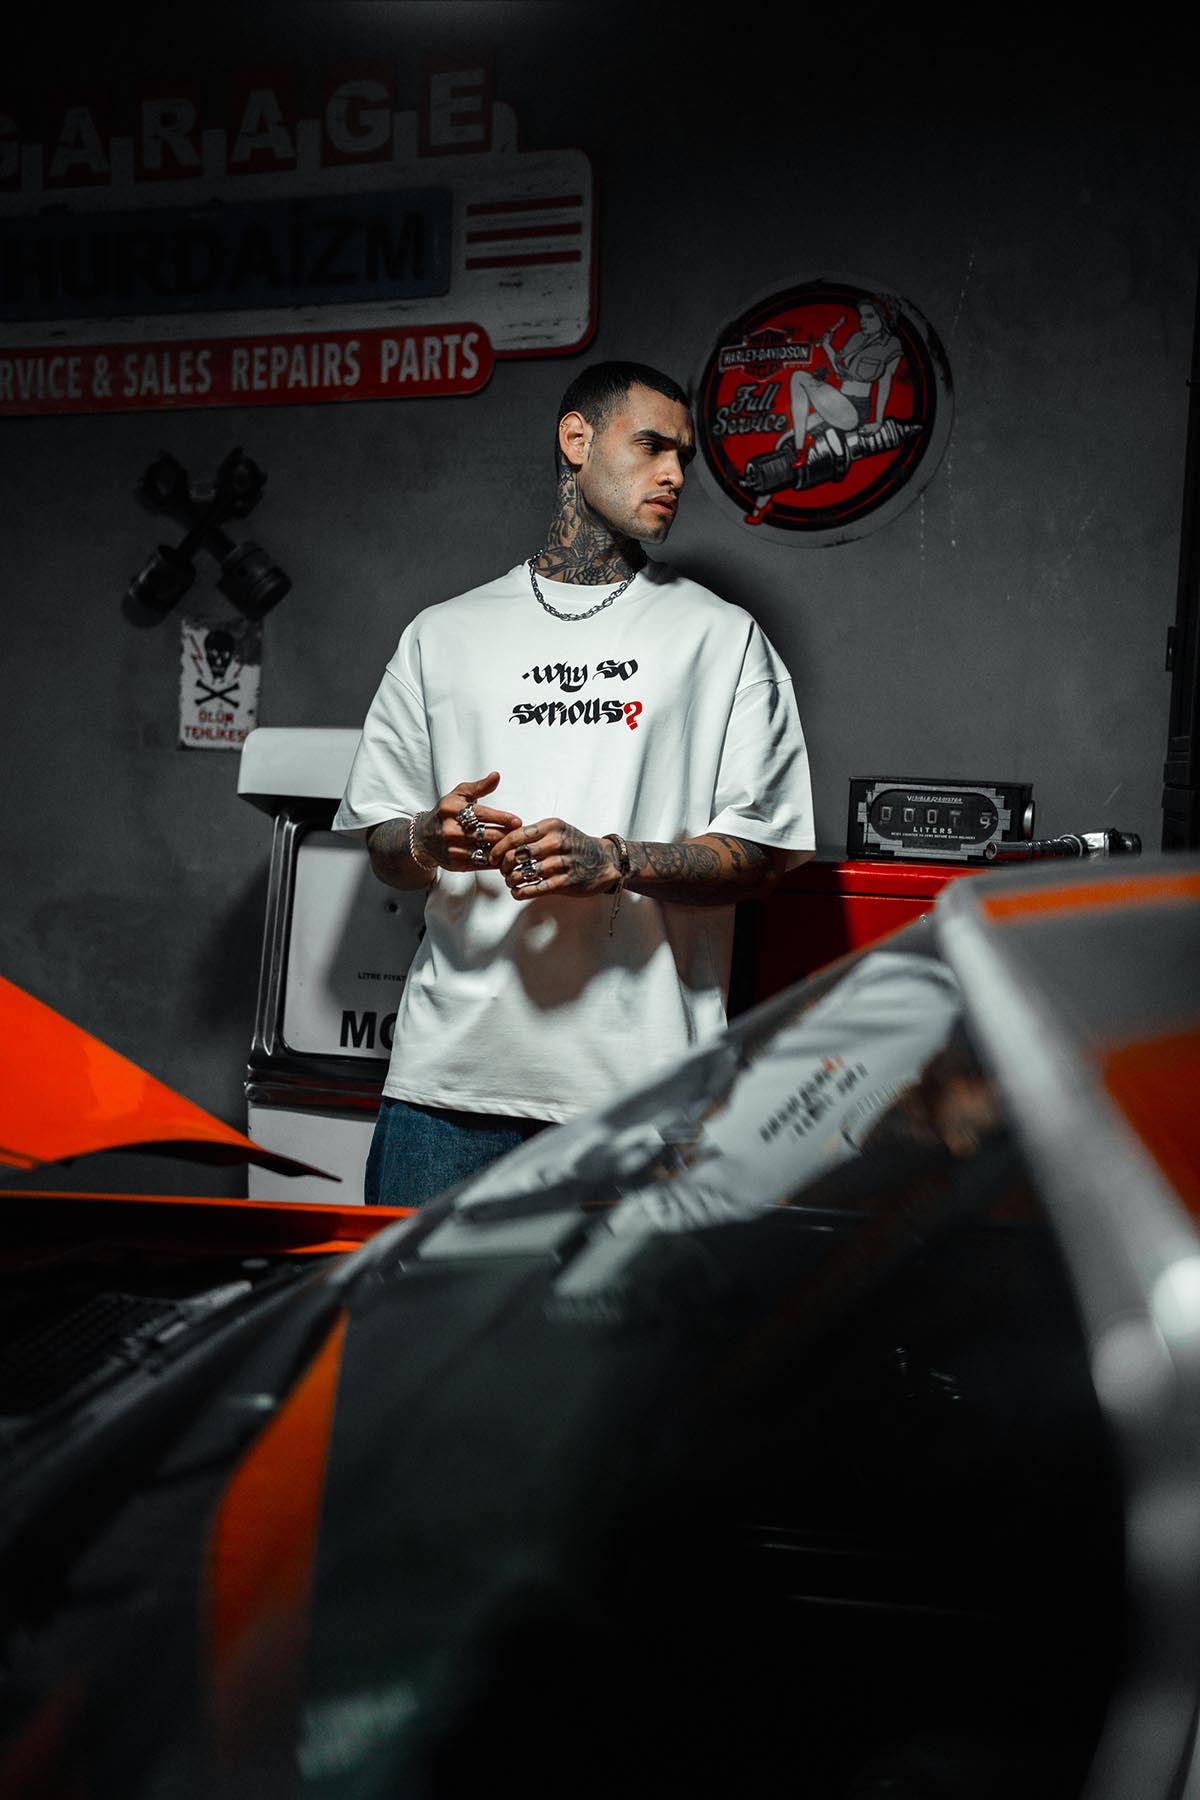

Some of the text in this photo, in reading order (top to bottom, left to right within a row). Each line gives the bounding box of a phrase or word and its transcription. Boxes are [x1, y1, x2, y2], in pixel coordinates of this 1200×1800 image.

[90, 352, 113, 397] &
[122, 349, 212, 396] SALES
[230, 339, 361, 392] REPAIRS
[379, 331, 481, 382] PARTS
[730, 383, 780, 414] Full
[712, 407, 786, 435] Service
[508, 697, 643, 730] serious?
[912, 826, 953, 835] LITERS
